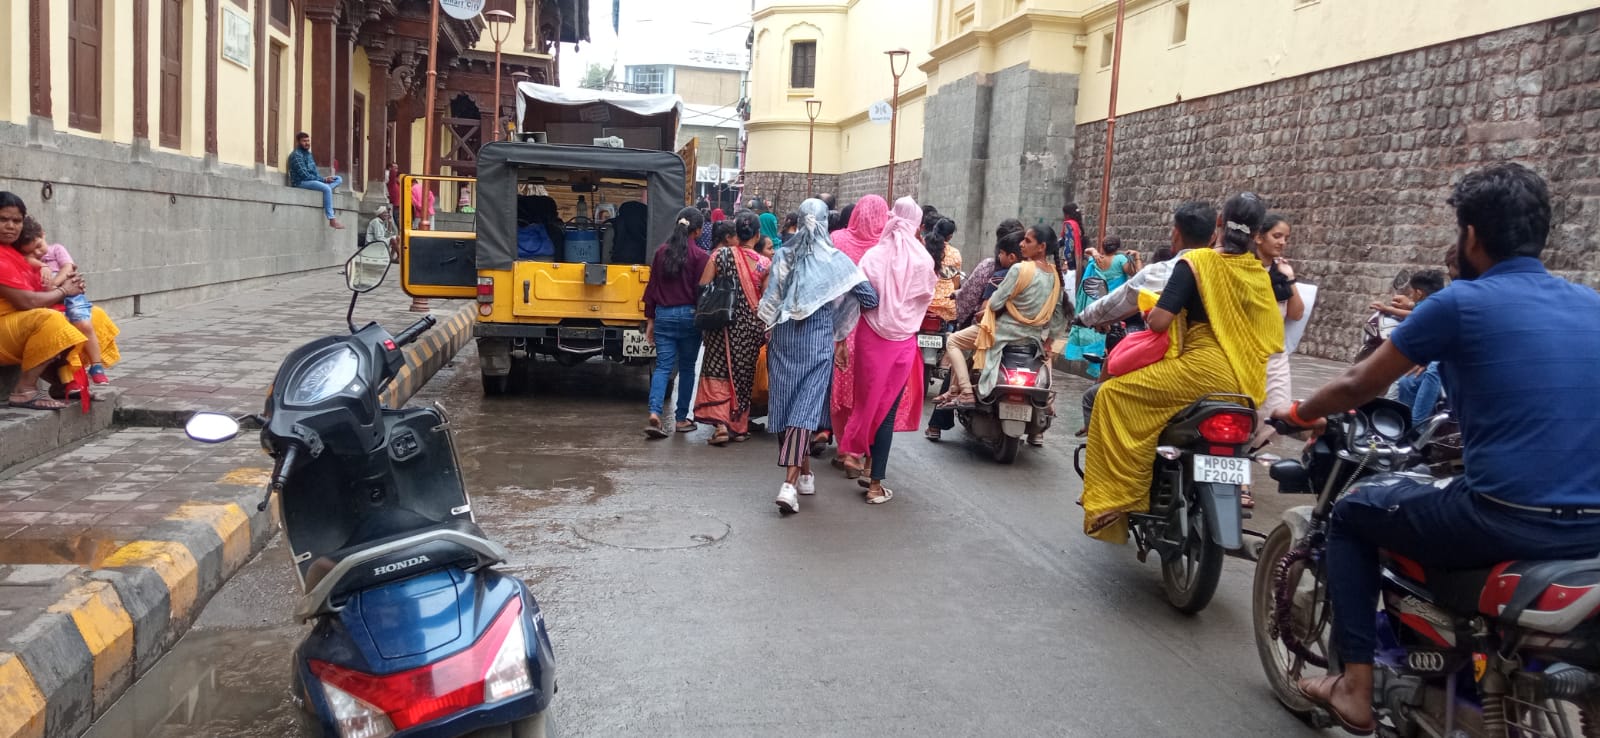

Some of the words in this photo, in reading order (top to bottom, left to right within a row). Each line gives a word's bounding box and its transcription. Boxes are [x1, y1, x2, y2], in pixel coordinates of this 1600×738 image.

[1204, 457, 1244, 471] MP09Z
[1204, 469, 1244, 485] F2040
[373, 555, 431, 577] HONDA
